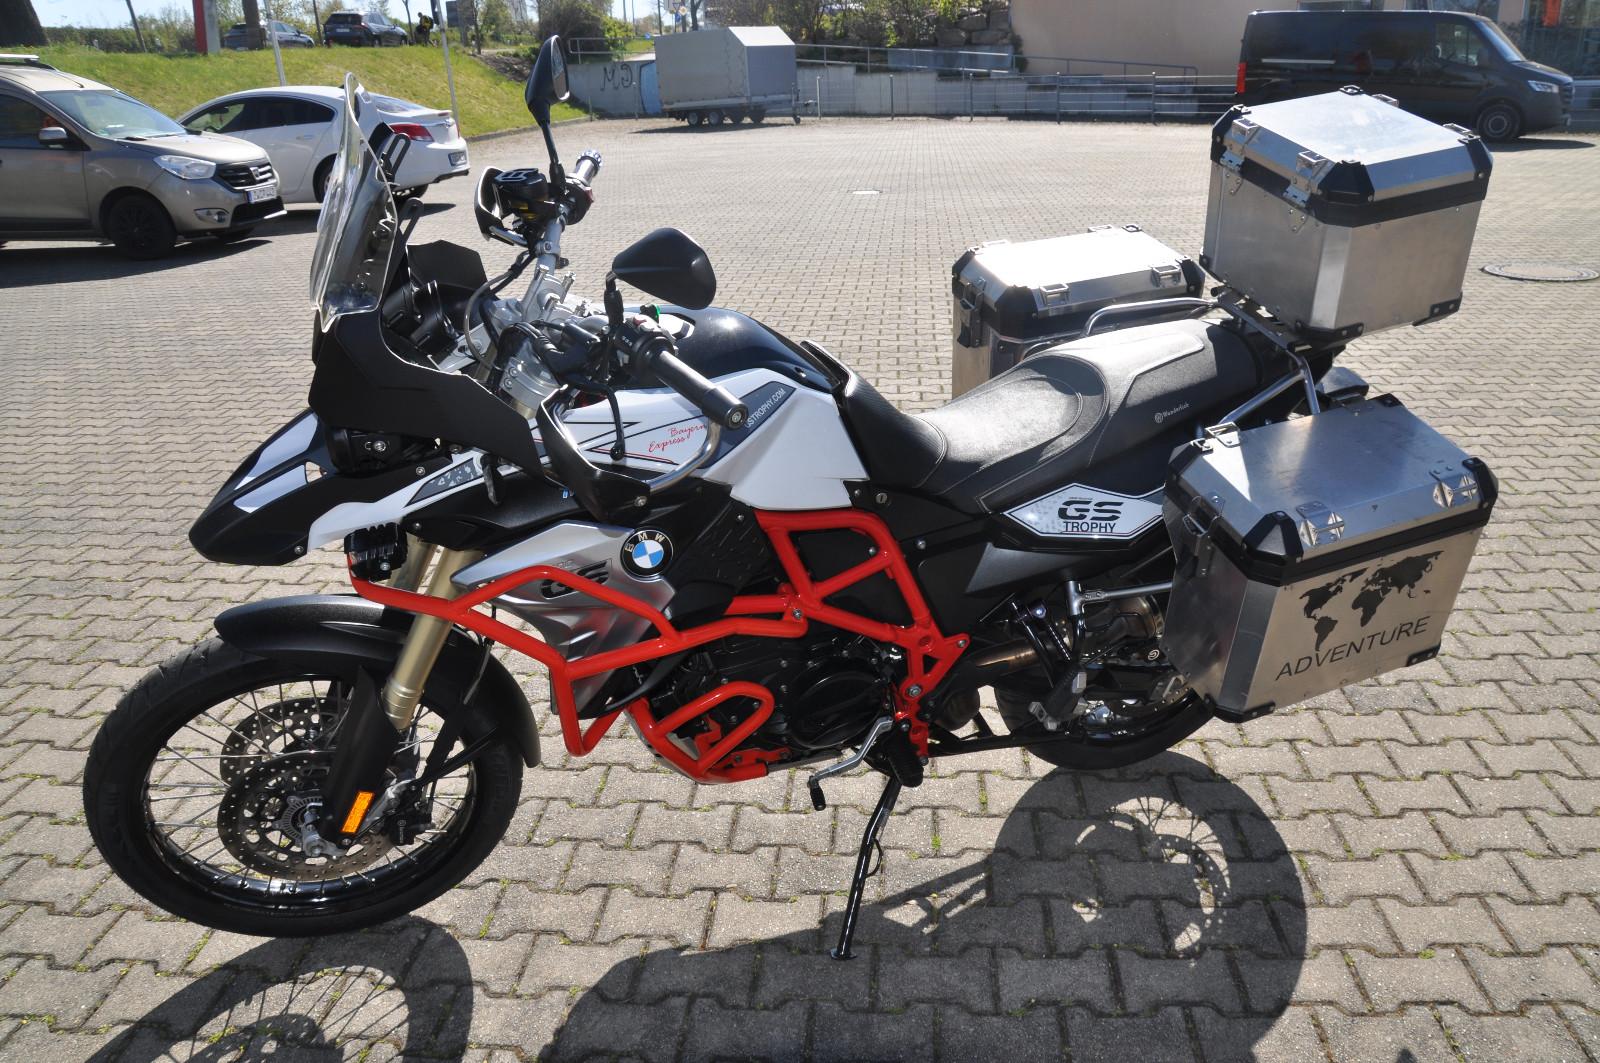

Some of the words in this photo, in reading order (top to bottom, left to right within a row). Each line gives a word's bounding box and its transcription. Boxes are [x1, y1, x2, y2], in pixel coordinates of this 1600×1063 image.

[667, 423, 706, 440] Bayern
[648, 436, 686, 453] Express
[1057, 500, 1124, 522] GS
[1063, 521, 1116, 533] TROPHY
[624, 531, 666, 553] BMW
[1274, 615, 1432, 682] ADVENTURE
